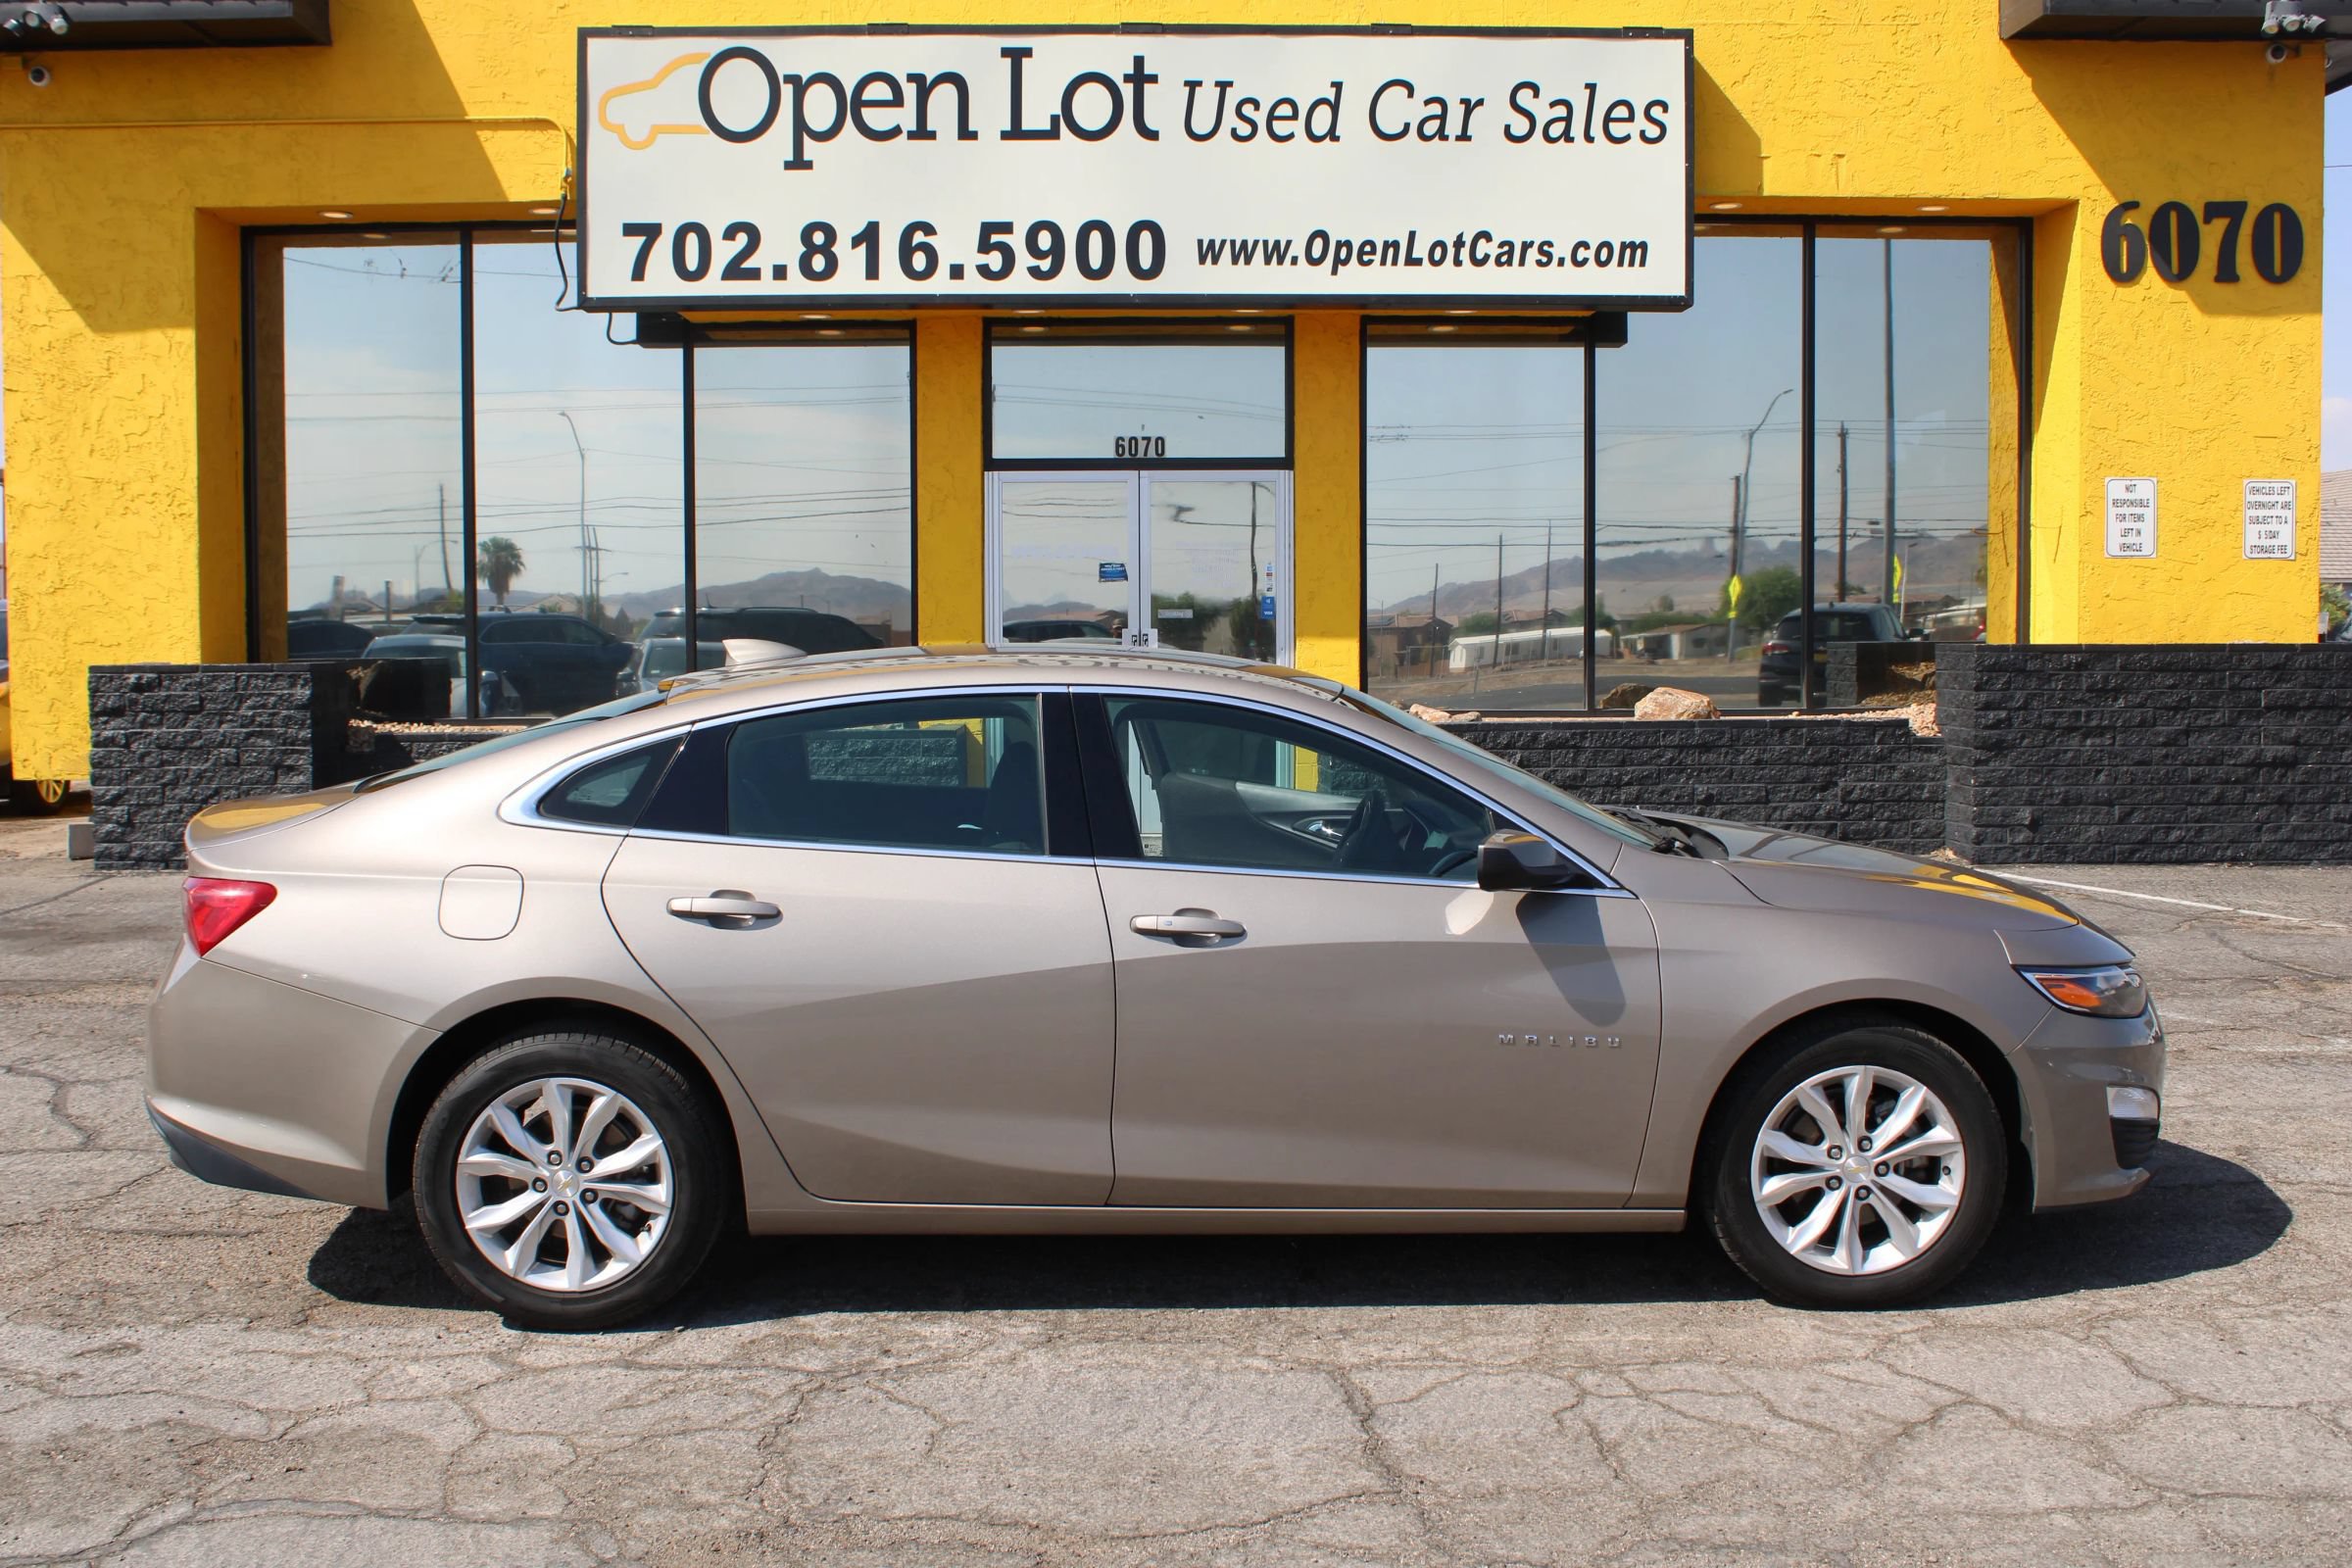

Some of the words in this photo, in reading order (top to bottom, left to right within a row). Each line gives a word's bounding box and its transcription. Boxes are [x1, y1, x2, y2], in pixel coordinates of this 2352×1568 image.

[698, 46, 978, 171] Open
[1000, 46, 1159, 142] Lot
[1183, 79, 1344, 143] Used
[1368, 78, 1484, 142] Car
[1503, 80, 1669, 144] Sales
[2101, 201, 2303, 283] 6070
[622, 220, 1166, 282] 702.816.5900
[1197, 229, 1648, 275] www.OpenLotCars.com
[1115, 436, 1165, 458] 6070
[2125, 484, 2137, 493] NOT
[2248, 486, 2276, 495] VEHICLES
[2277, 486, 2290, 495] LEFT
[2112, 499, 2150, 508] RESPONSIBLE
[2247, 501, 2279, 510] OVERNIGHT
[2280, 501, 2292, 510] ARE
[2115, 514, 2127, 522] FOR
[2128, 514, 2145, 522] ITEMS
[2248, 515, 2275, 525] SUBJECT
[2275, 515, 2283, 525] TO
[2283, 515, 2288, 525] A
[2120, 528, 2134, 537] LEFT
[2135, 528, 2141, 537] IN
[2119, 543, 2143, 552] VEHICLE
[2249, 545, 2275, 554] STORAGE
[2277, 545, 2288, 554] FEE
[1498, 1034, 1620, 1047] MALIBU
